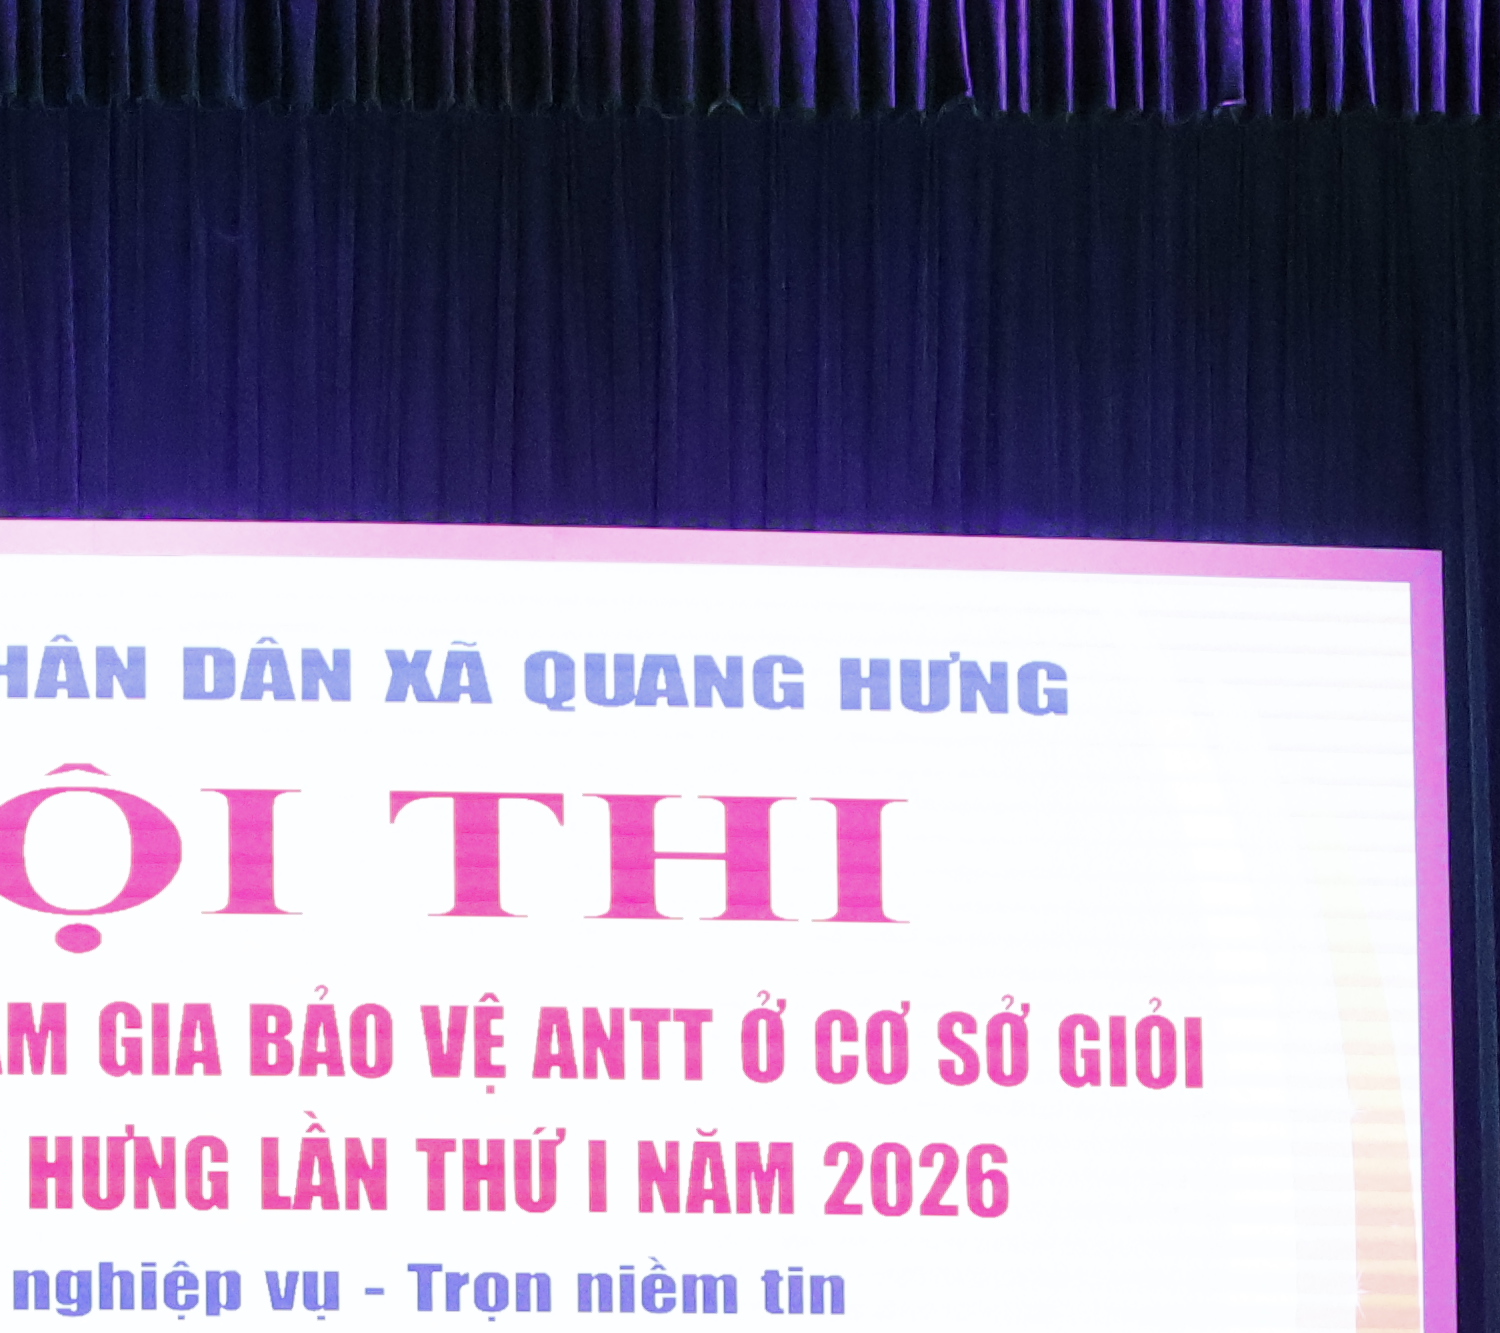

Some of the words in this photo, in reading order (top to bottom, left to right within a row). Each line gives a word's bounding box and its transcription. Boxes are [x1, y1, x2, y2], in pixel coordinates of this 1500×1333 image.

[182, 636, 353, 702] DÂN
[384, 640, 493, 704] XÃ
[524, 650, 806, 712] QUANG
[840, 647, 1070, 717] HƯNG
[389, 790, 910, 924] THI
[99, 1001, 222, 1078] GIA
[249, 984, 394, 1079] BẢO
[420, 992, 507, 1094] VỆ
[531, 1006, 714, 1081] ANTT
[740, 990, 788, 1084] Ở
[814, 1000, 911, 1086] CƠ
[937, 994, 1032, 1087] SỞ
[1058, 997, 1204, 1090] GIỎI
[28, 1124, 230, 1211] HƯNG
[260, 1110, 389, 1211] LẦN
[415, 1126, 568, 1214] THỨ
[588, 1139, 608, 1213] I
[637, 1128, 796, 1215] NĂM
[823, 1141, 1010, 1218] 2026
[13, 1260, 243, 1320] nghiệp
[265, 1271, 341, 1320] vụ
[364, 1286, 386, 1296] -
[407, 1263, 552, 1321] Trọn
[577, 1256, 738, 1314] niềm
[761, 1266, 846, 1315] tin
